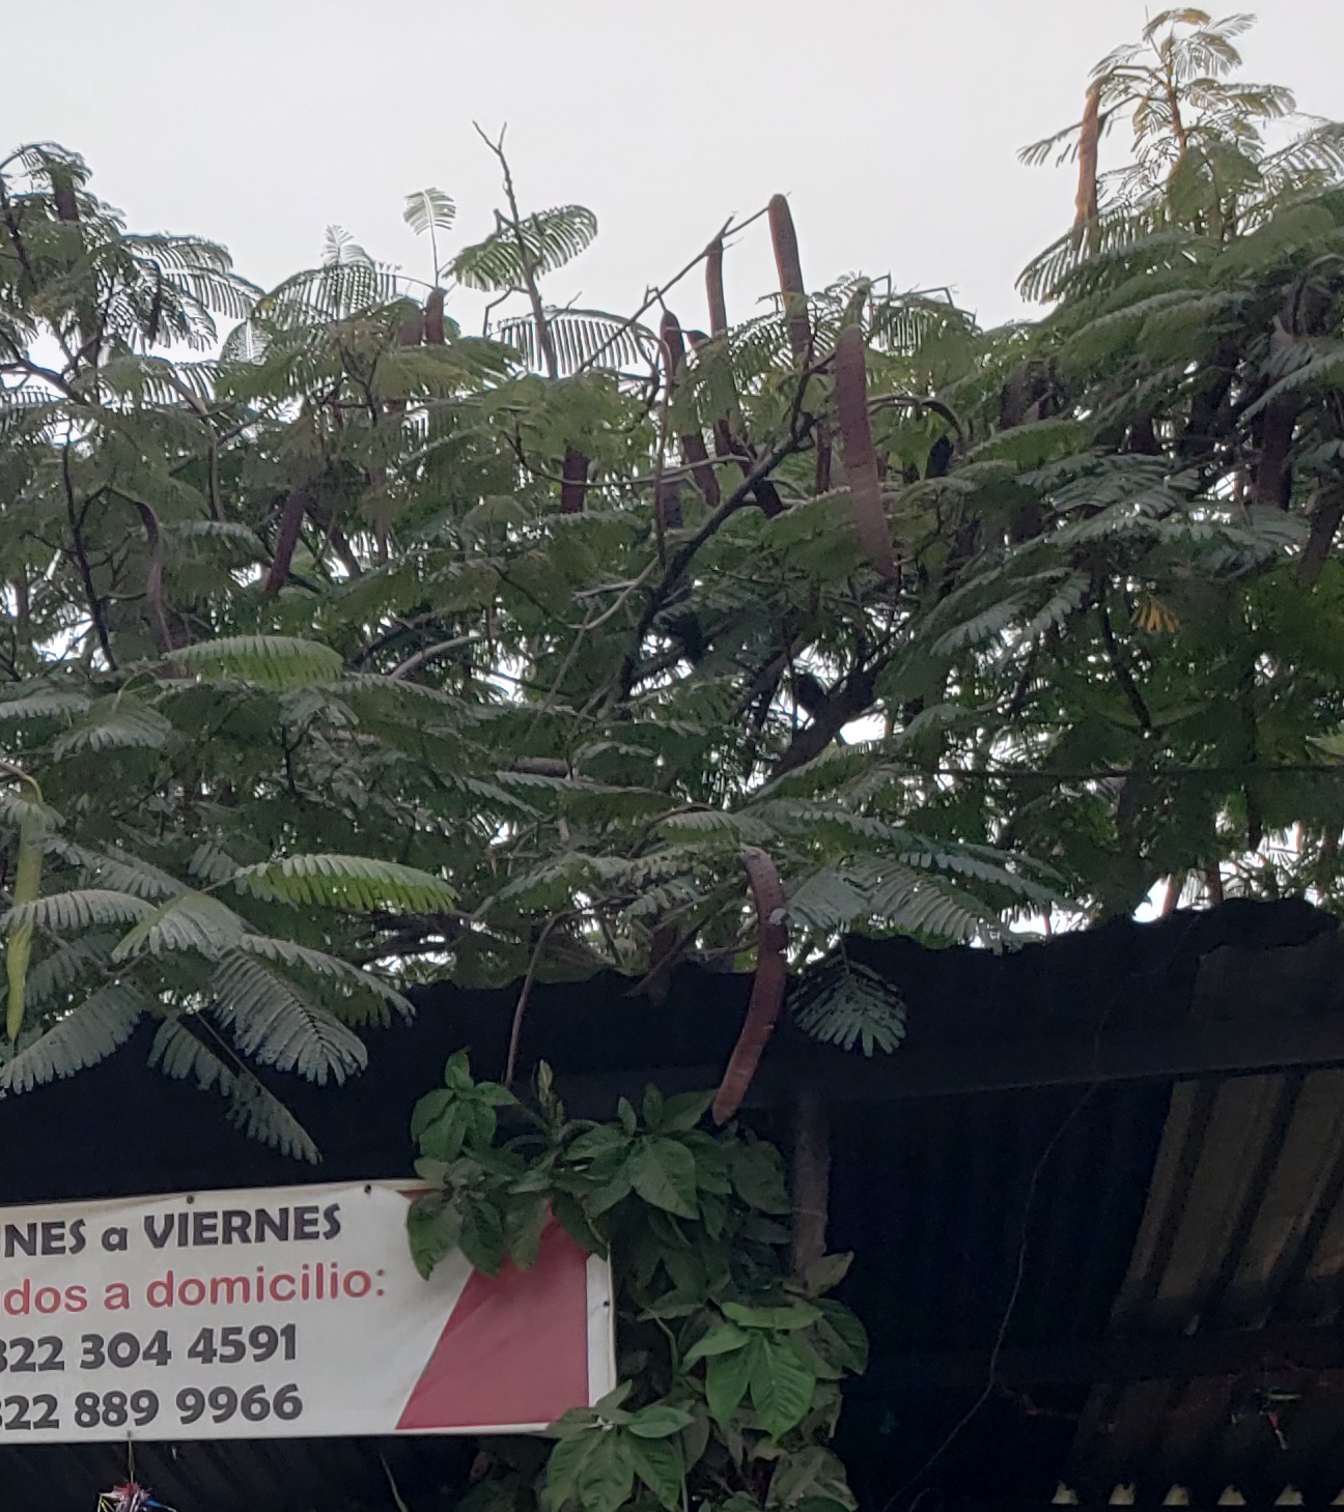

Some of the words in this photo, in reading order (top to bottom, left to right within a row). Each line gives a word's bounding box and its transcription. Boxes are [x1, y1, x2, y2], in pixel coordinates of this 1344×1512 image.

[101, 1226, 129, 1252] a
[143, 1203, 341, 1250] VIERNES
[103, 1281, 130, 1311] a
[147, 1262, 386, 1308] domicilio:
[80, 1331, 172, 1370] 304
[188, 1323, 297, 1365] 4591
[74, 1389, 160, 1428] 889
[175, 1383, 304, 1425] 9966
